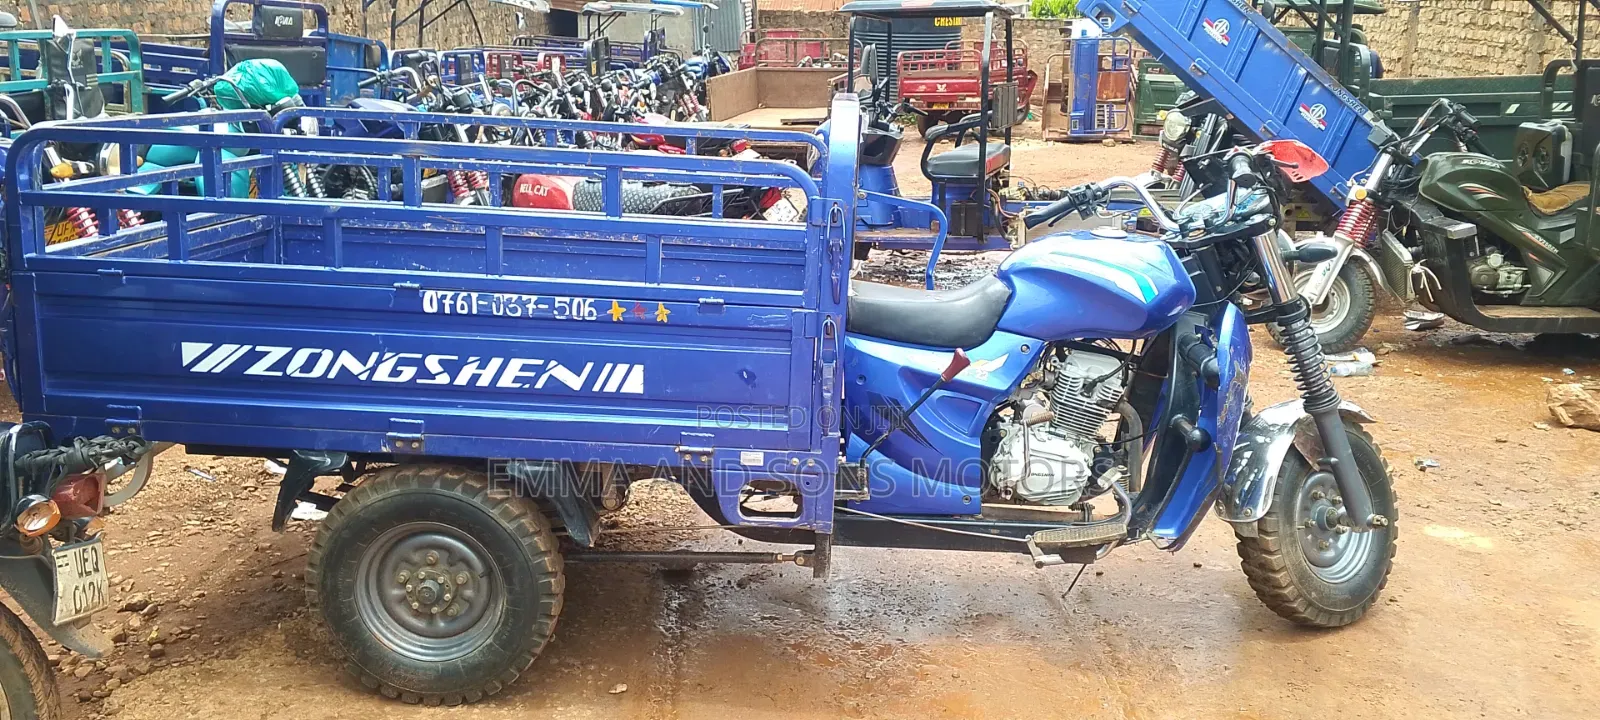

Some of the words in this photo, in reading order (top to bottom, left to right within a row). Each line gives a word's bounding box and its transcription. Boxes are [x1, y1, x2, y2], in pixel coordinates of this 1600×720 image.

[422, 289, 598, 321] 0761-037-506
[243, 344, 594, 393] ZONGSHEN
[74, 546, 100, 578] UEQ
